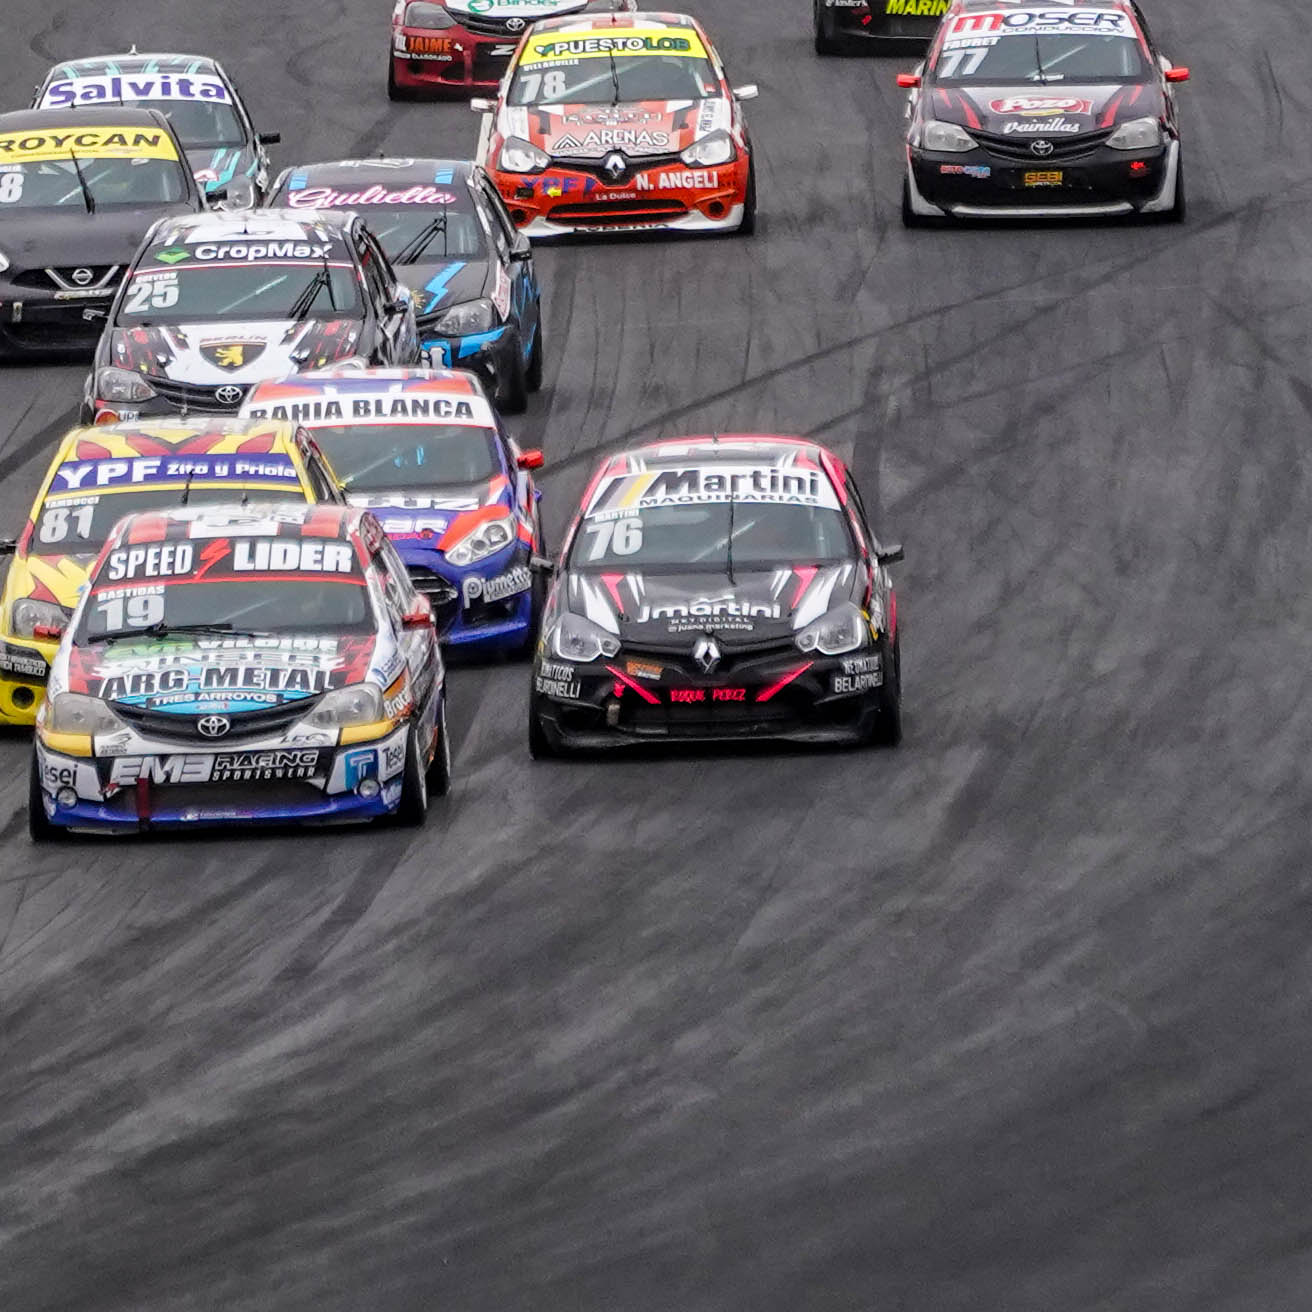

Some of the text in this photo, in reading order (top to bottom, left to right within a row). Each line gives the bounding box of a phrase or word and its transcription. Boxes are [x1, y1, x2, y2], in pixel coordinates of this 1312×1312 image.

[940, 47, 990, 79] 77
[48, 75, 227, 106] Salvita
[519, 70, 567, 104] 78
[582, 130, 670, 147] ARENAS
[636, 171, 719, 191] N. ANGELI
[194, 239, 334, 261] CropMax
[124, 277, 181, 315] 25
[250, 399, 474, 422] BAHIA BLANCA
[57, 458, 162, 490] YPF
[166, 463, 209, 477] Zito
[215, 463, 229, 477] y
[643, 469, 820, 497] Martini
[640, 494, 819, 507] MAQUINARIAS
[40, 505, 95, 545] 81
[595, 509, 640, 523] MARTINI
[587, 518, 644, 562] 76
[109, 541, 354, 581] SPEED LIDER
[98, 585, 165, 602] BASTIDAS
[99, 595, 165, 632] 19
[153, 690, 278, 706] TRES ARROYOS
[215, 751, 319, 771] RACING
[212, 766, 318, 783] SPORTSWEAR
